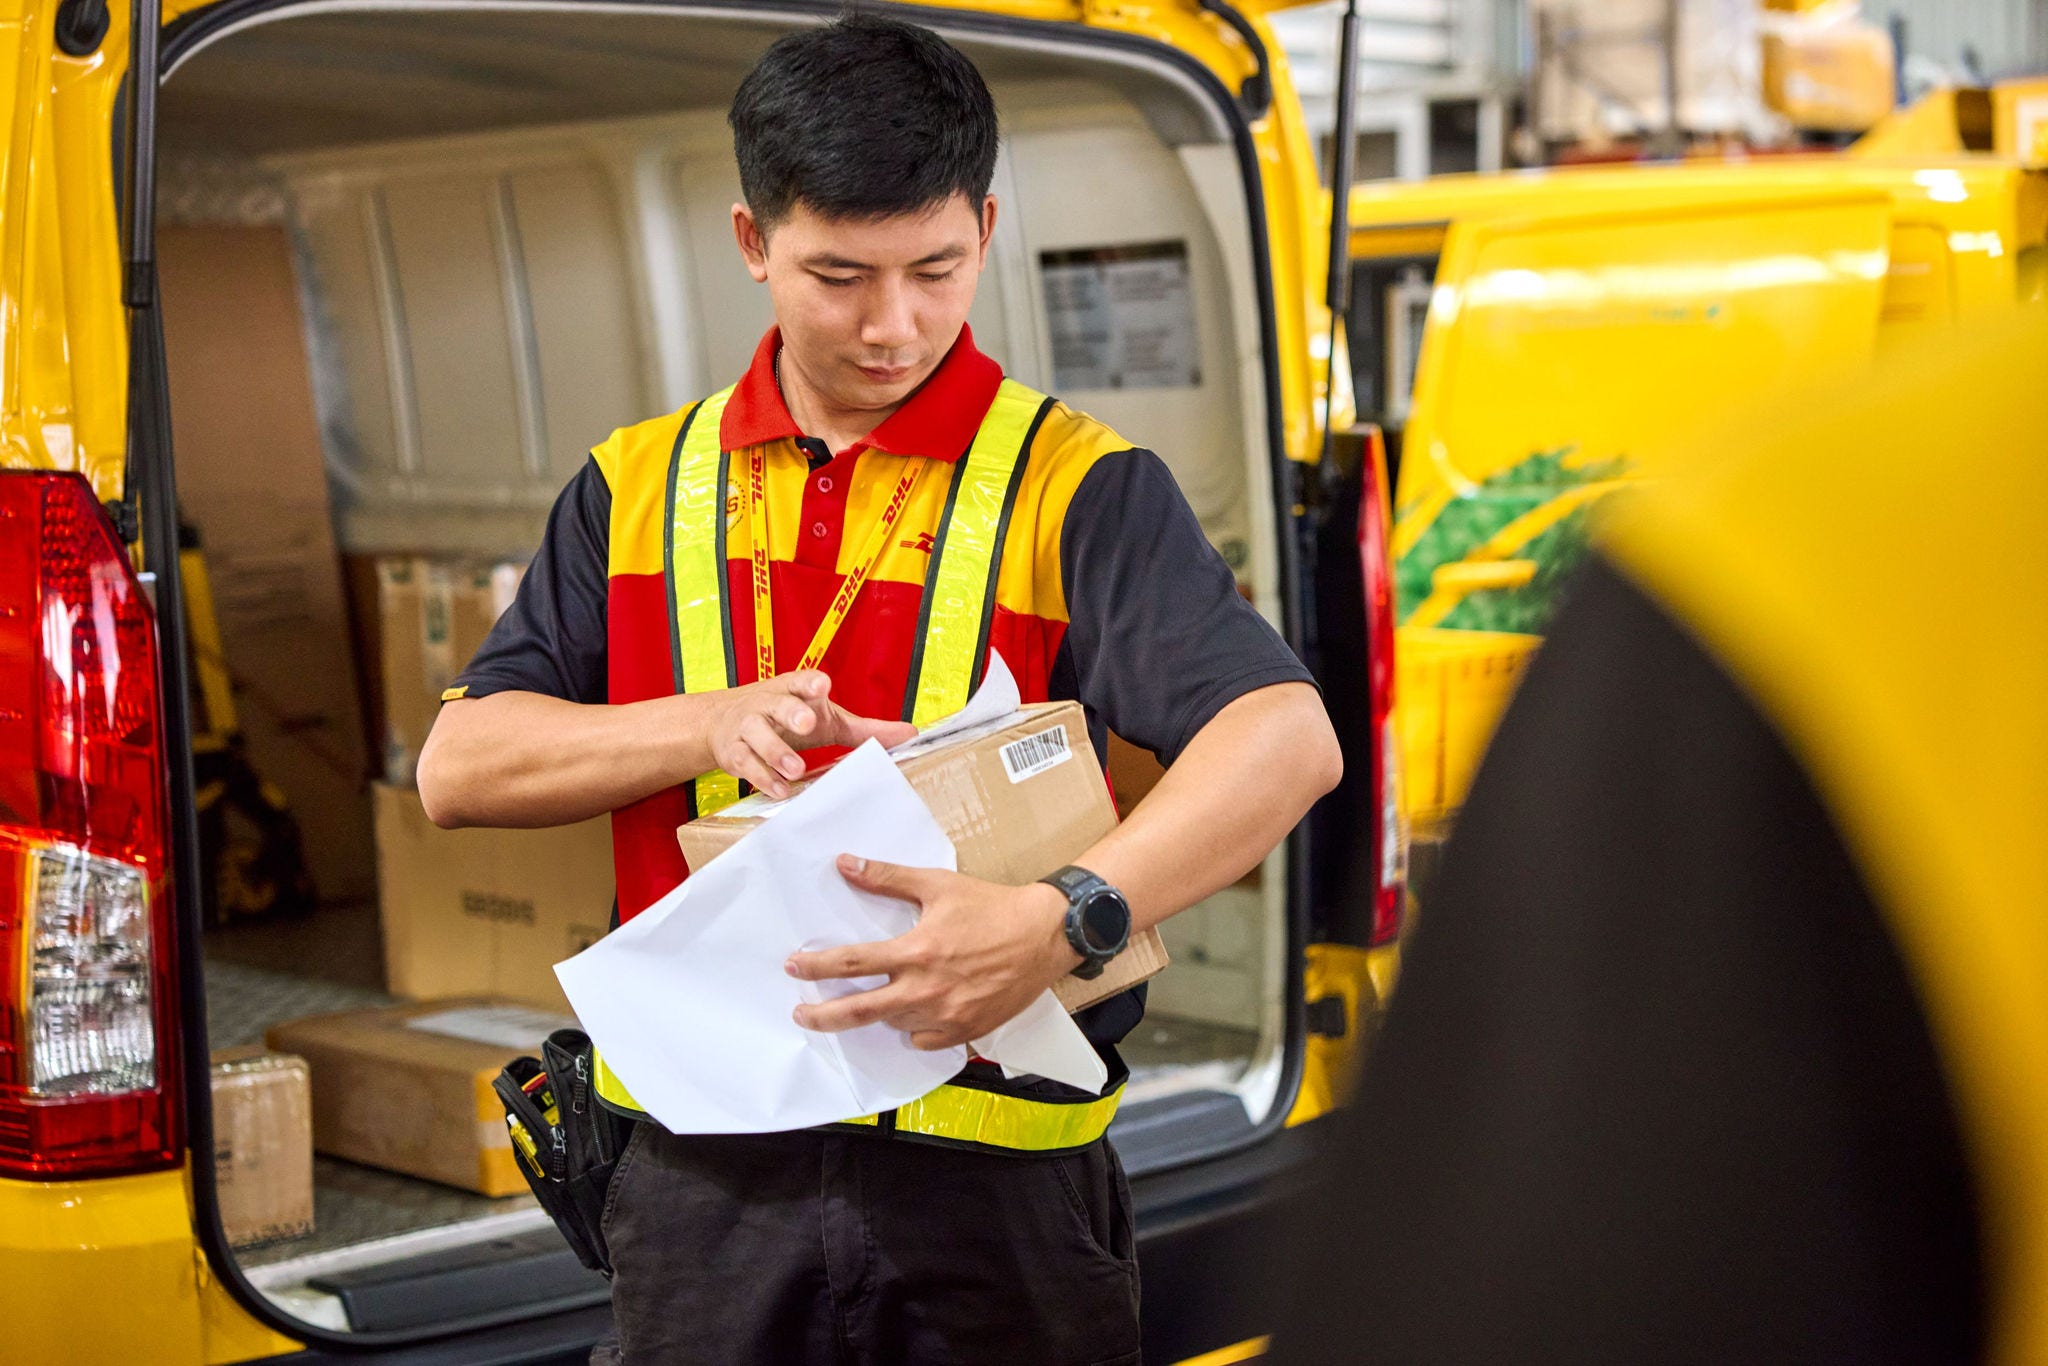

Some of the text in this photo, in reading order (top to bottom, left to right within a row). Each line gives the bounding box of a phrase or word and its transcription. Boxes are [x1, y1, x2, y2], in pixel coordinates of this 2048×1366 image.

[751, 456, 762, 504] DHL
[882, 476, 914, 526] DHL
[754, 548, 768, 599] DHL
[834, 566, 866, 616] DHL
[760, 645, 773, 679] DH
